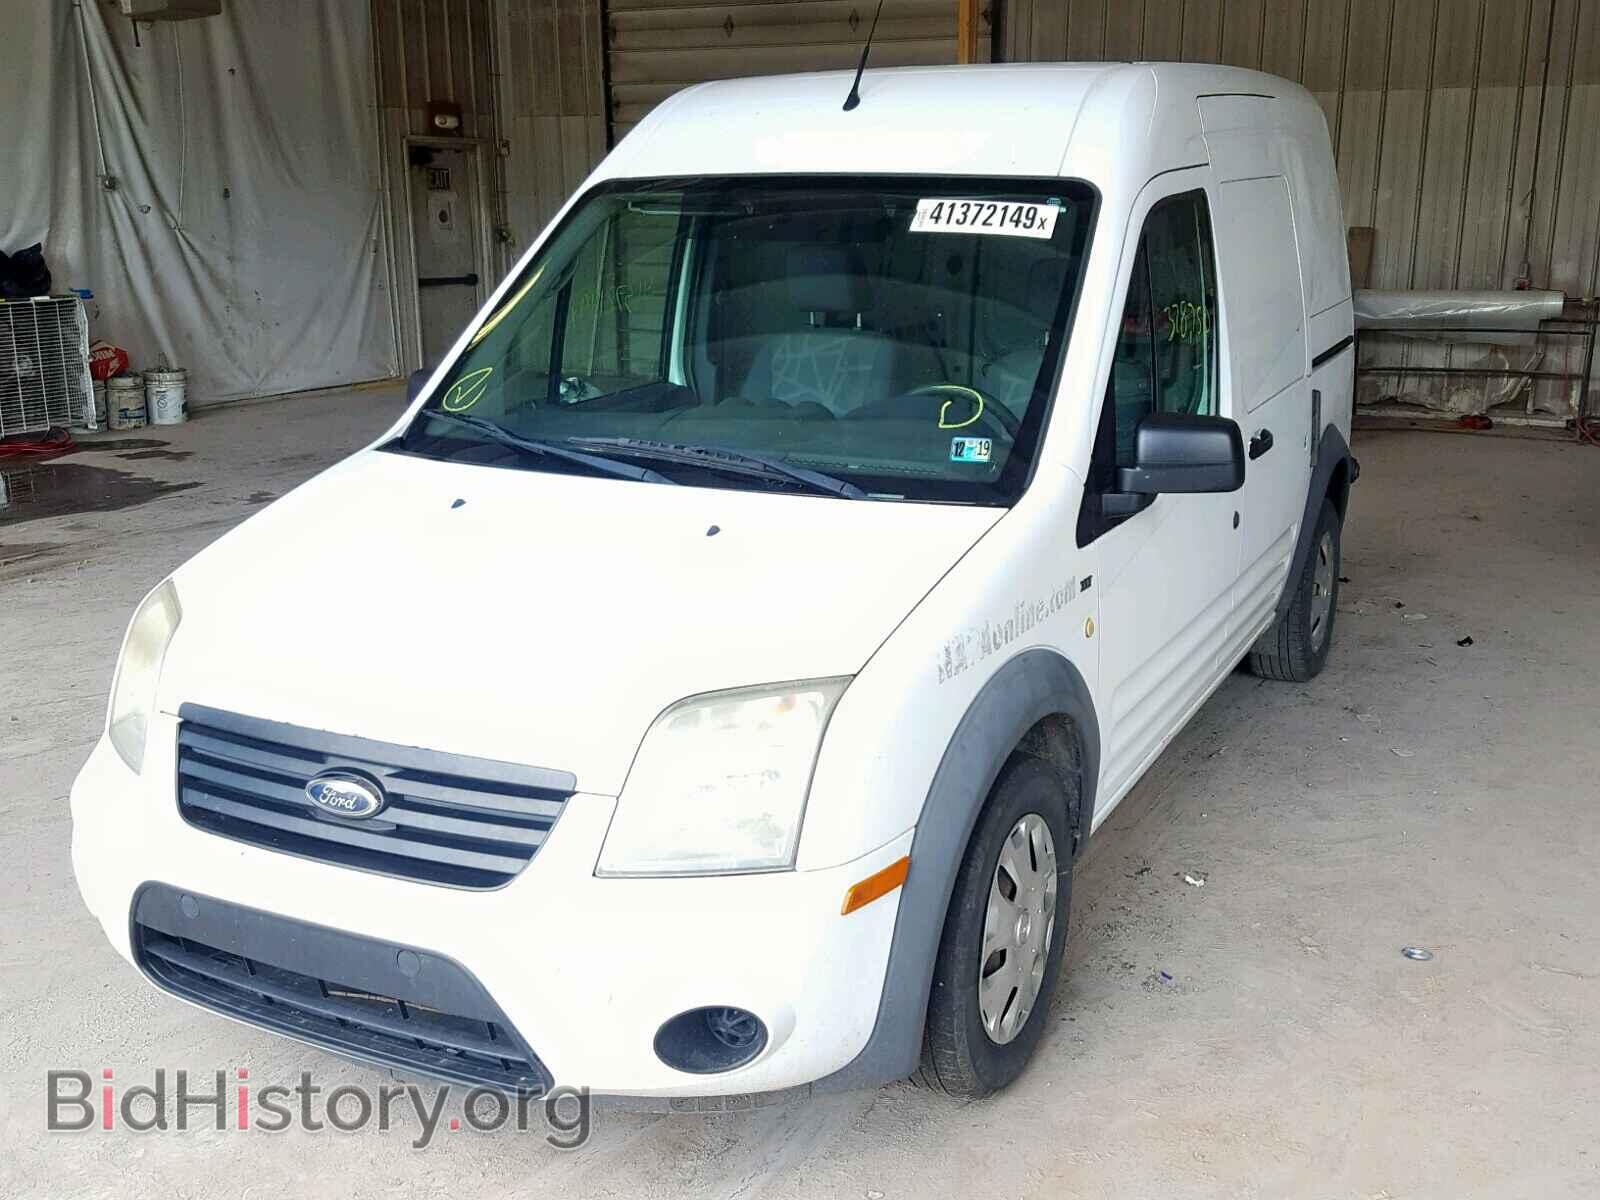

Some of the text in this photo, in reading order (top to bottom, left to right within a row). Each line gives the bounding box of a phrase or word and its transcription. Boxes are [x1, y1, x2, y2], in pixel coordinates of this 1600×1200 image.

[954, 440, 990, 457] 12 19
[318, 784, 358, 811] Ford
